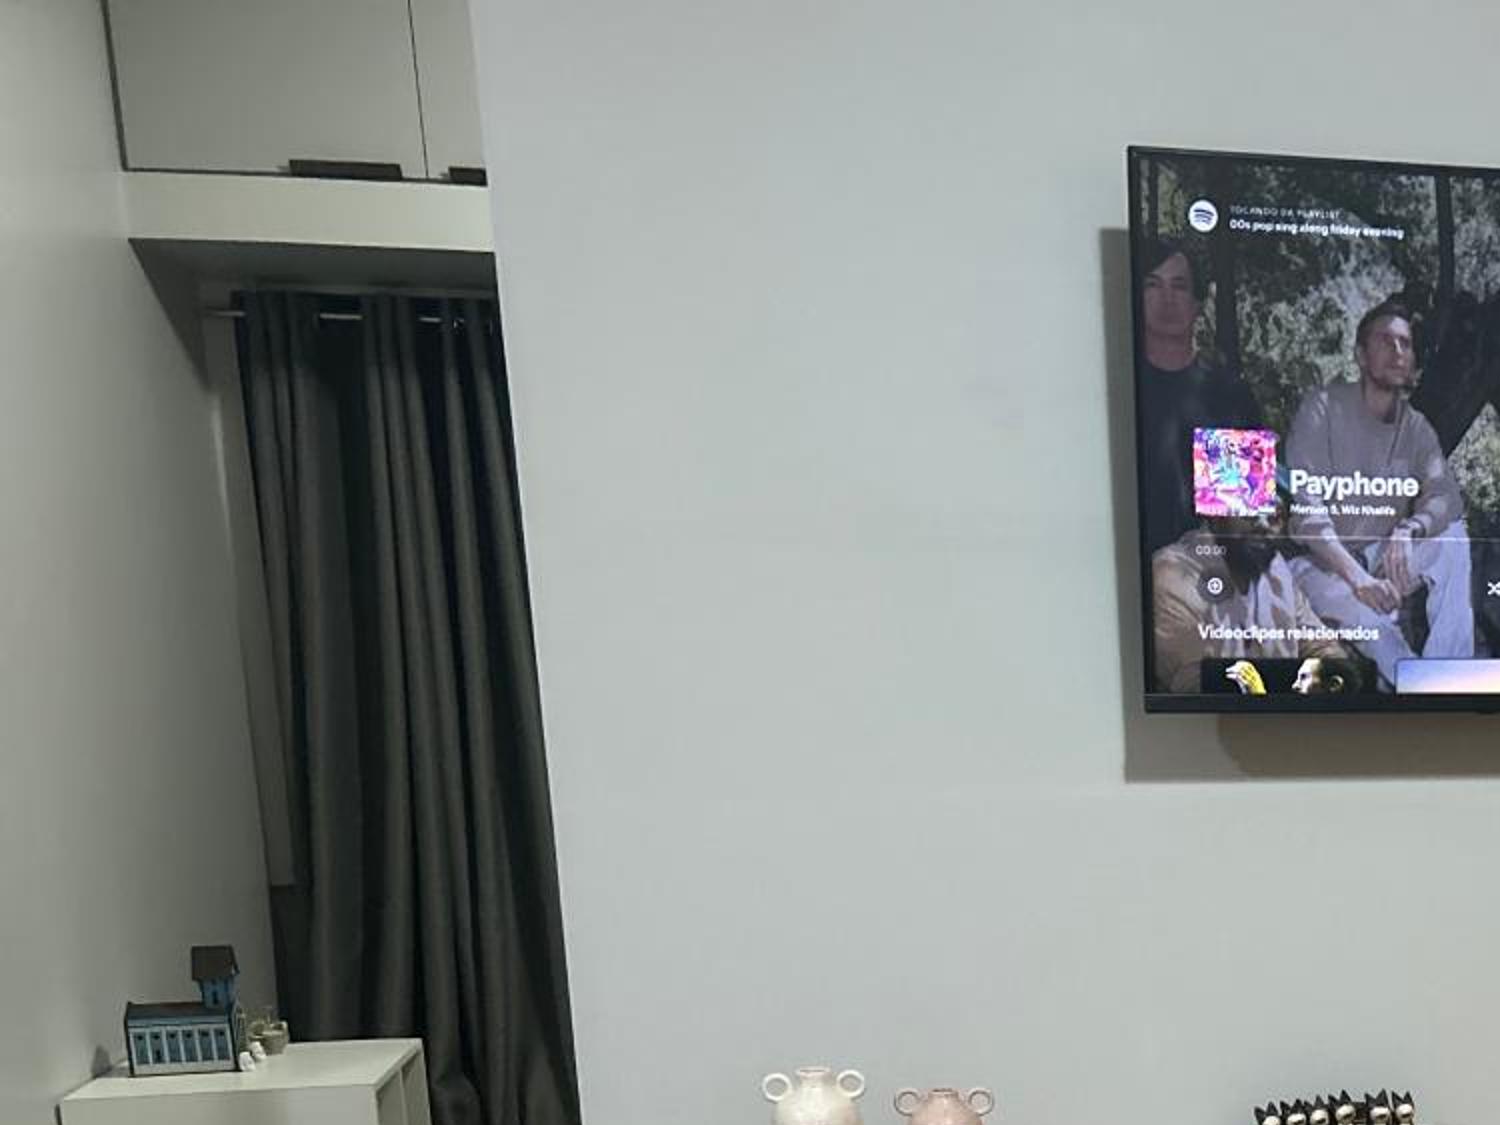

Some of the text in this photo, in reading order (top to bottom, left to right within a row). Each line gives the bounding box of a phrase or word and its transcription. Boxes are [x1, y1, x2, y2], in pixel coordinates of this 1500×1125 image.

[1290, 469, 1419, 501] Payphone
[1197, 623, 1379, 643] Videoclipes relacionados
